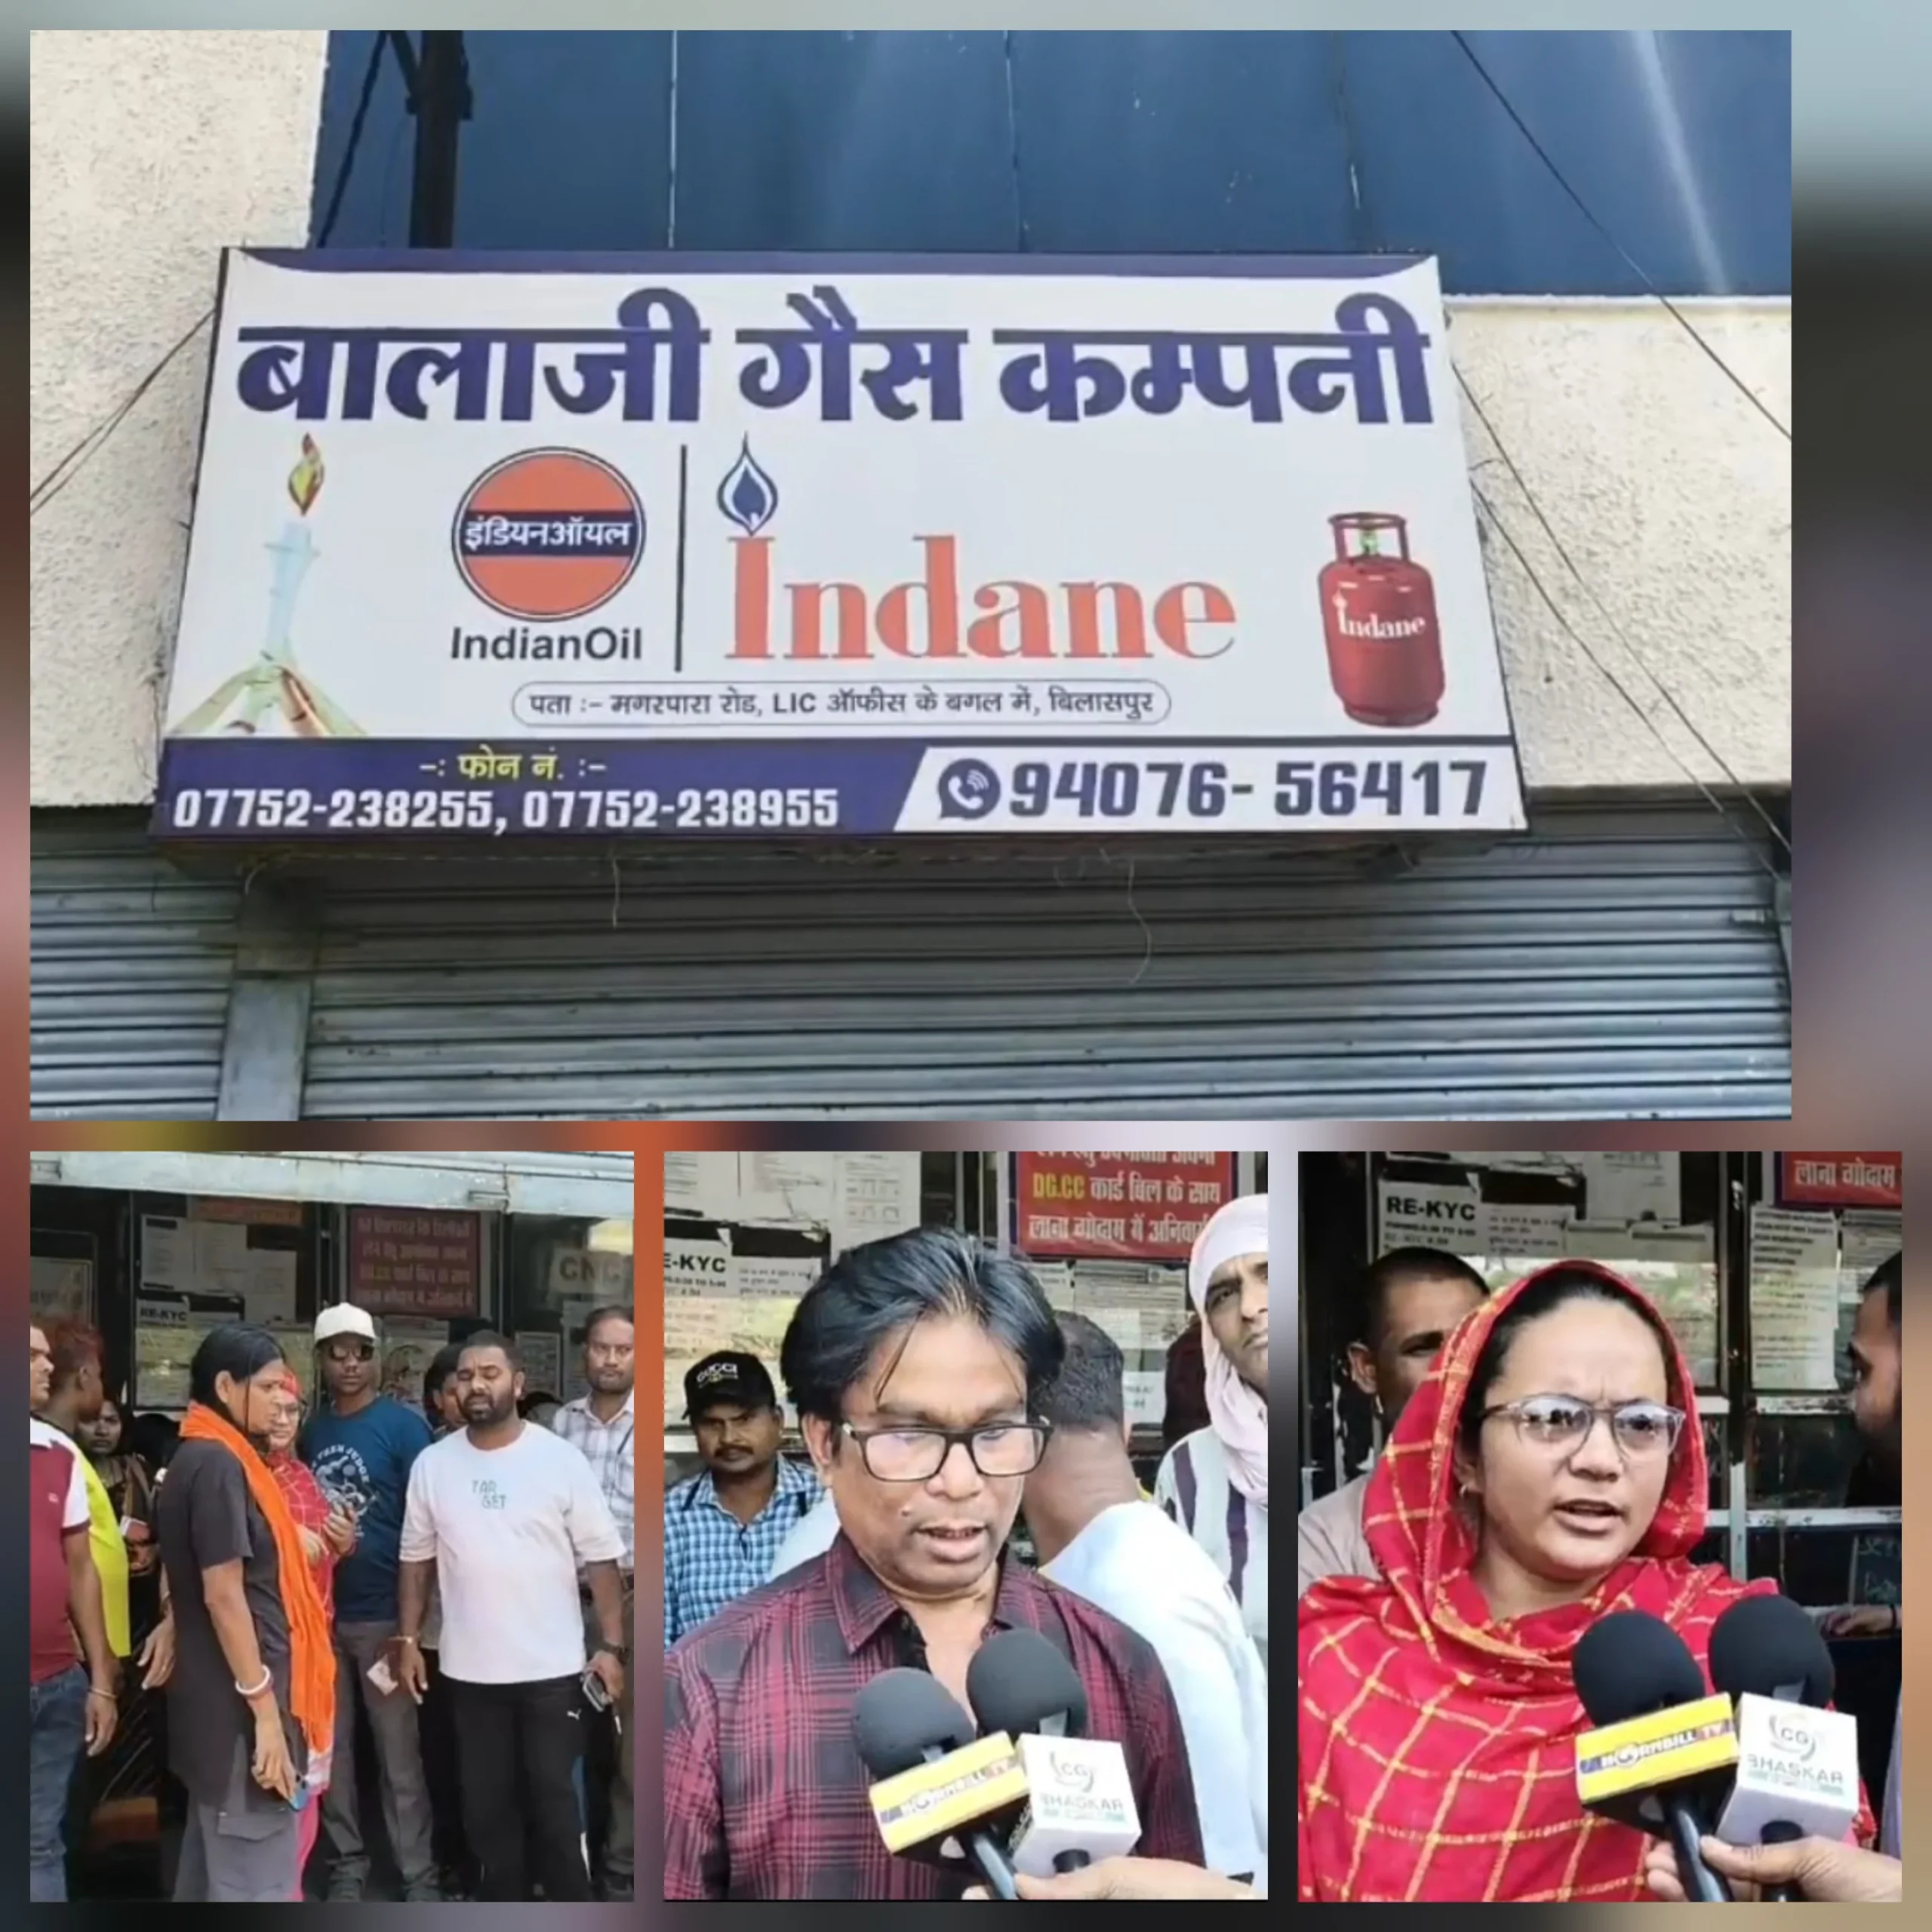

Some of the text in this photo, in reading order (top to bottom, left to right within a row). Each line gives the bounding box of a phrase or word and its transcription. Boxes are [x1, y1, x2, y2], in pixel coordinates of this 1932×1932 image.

[237, 286, 1434, 423] बालाजी गैस कम्पनी
[465, 515, 632, 549] इंडियनऑयल
[724, 534, 1236, 660] Indane
[1337, 608, 1426, 638] Indane
[451, 627, 642, 660] IndianOil
[528, 694, 571, 715] पता
[611, 694, 711, 715] मगरपारा
[719, 686, 764, 717] रोड,
[773, 692, 817, 713] LIC
[826, 686, 906, 712] ऑफीस
[915, 685, 937, 712] के
[944, 691, 1003, 713] बगल
[1011, 685, 1040, 716] में,
[1048, 685, 1154, 719] बिलासपुर
[456, 743, 523, 780] फोन
[530, 746, 565, 780] नं.
[1010, 760, 1487, 818] 94076- 56417
[172, 788, 840, 835] 07752-238255, 07752-238955
[1090, 1170, 1125, 1201] कार्ड
[1129, 1171, 1162, 1203] बिल
[1166, 1175, 1184, 1204] के
[1795, 1157, 1896, 1189] लाना गोदाम
[1386, 1195, 1476, 1221] RE-KYC
